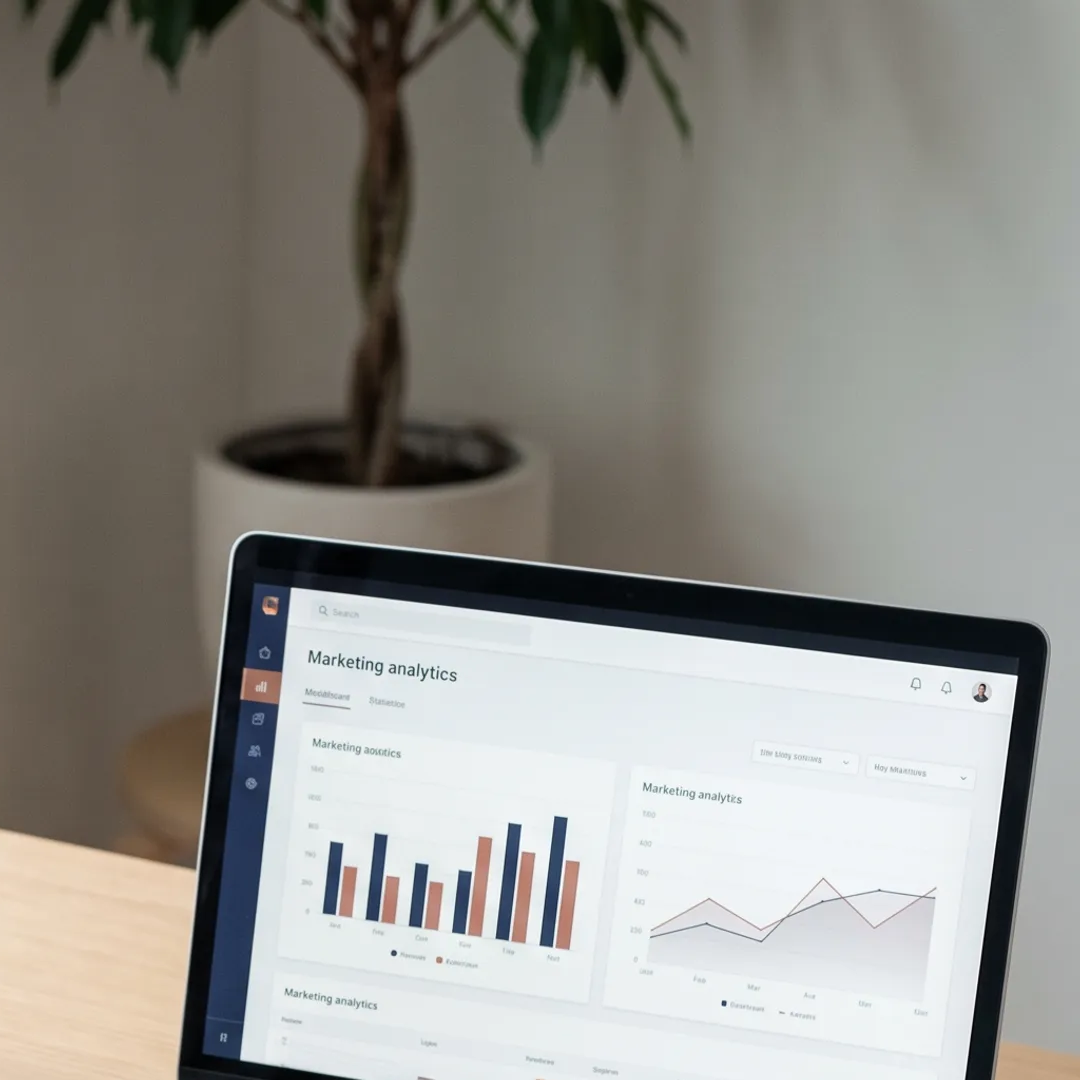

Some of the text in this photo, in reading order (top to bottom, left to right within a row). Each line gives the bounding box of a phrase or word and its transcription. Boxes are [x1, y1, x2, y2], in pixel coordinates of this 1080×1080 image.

[307, 649, 458, 683] Marketing analytics
[311, 737, 362, 755] Marketing
[641, 781, 696, 801] Marketing
[283, 987, 379, 1011] Marketing analytics
